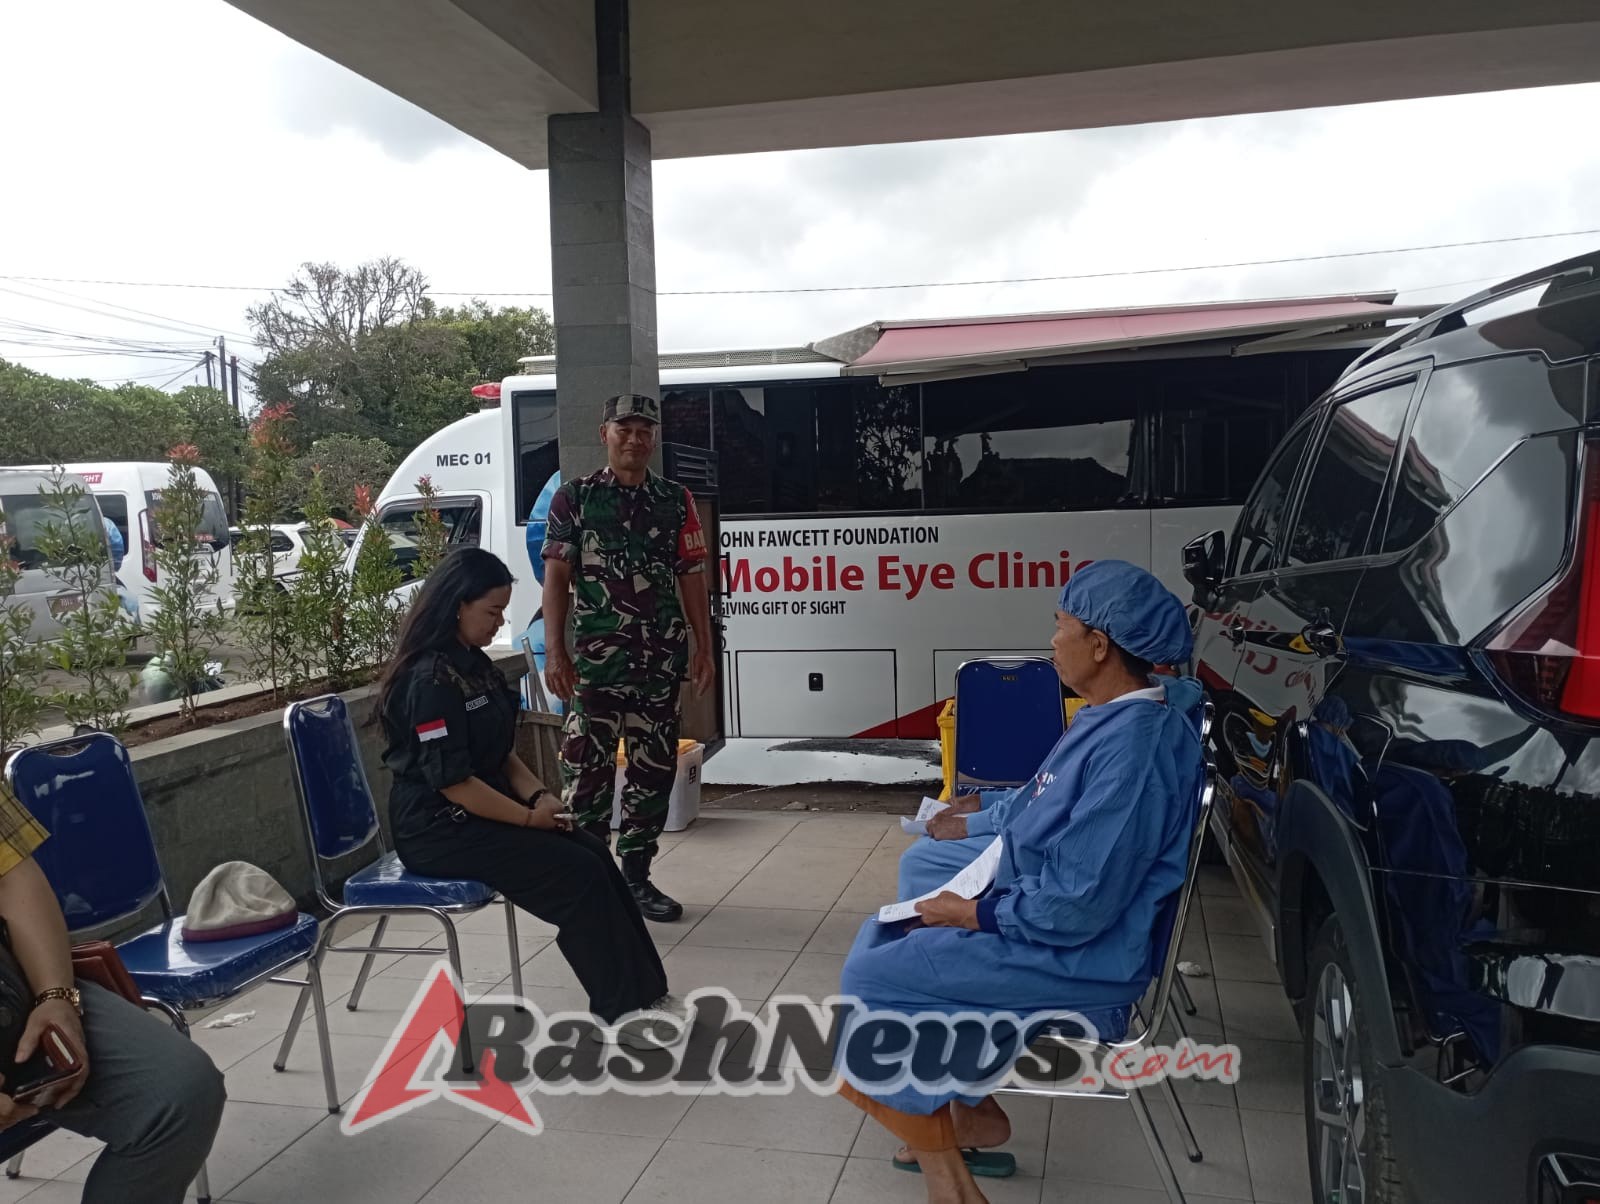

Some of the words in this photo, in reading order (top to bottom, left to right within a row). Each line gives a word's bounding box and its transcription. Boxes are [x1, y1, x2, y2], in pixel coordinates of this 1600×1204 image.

[436, 453, 470, 467] MEC
[474, 452, 491, 465] 01
[720, 531, 754, 548] OHN
[758, 529, 830, 547] FAWCETT
[833, 526, 939, 546] FOUNDATION
[720, 555, 865, 593] Mobile
[878, 555, 956, 600] Eye
[762, 601, 788, 615] GIFT
[791, 601, 807, 615] OF
[810, 600, 847, 615] SIGHT
